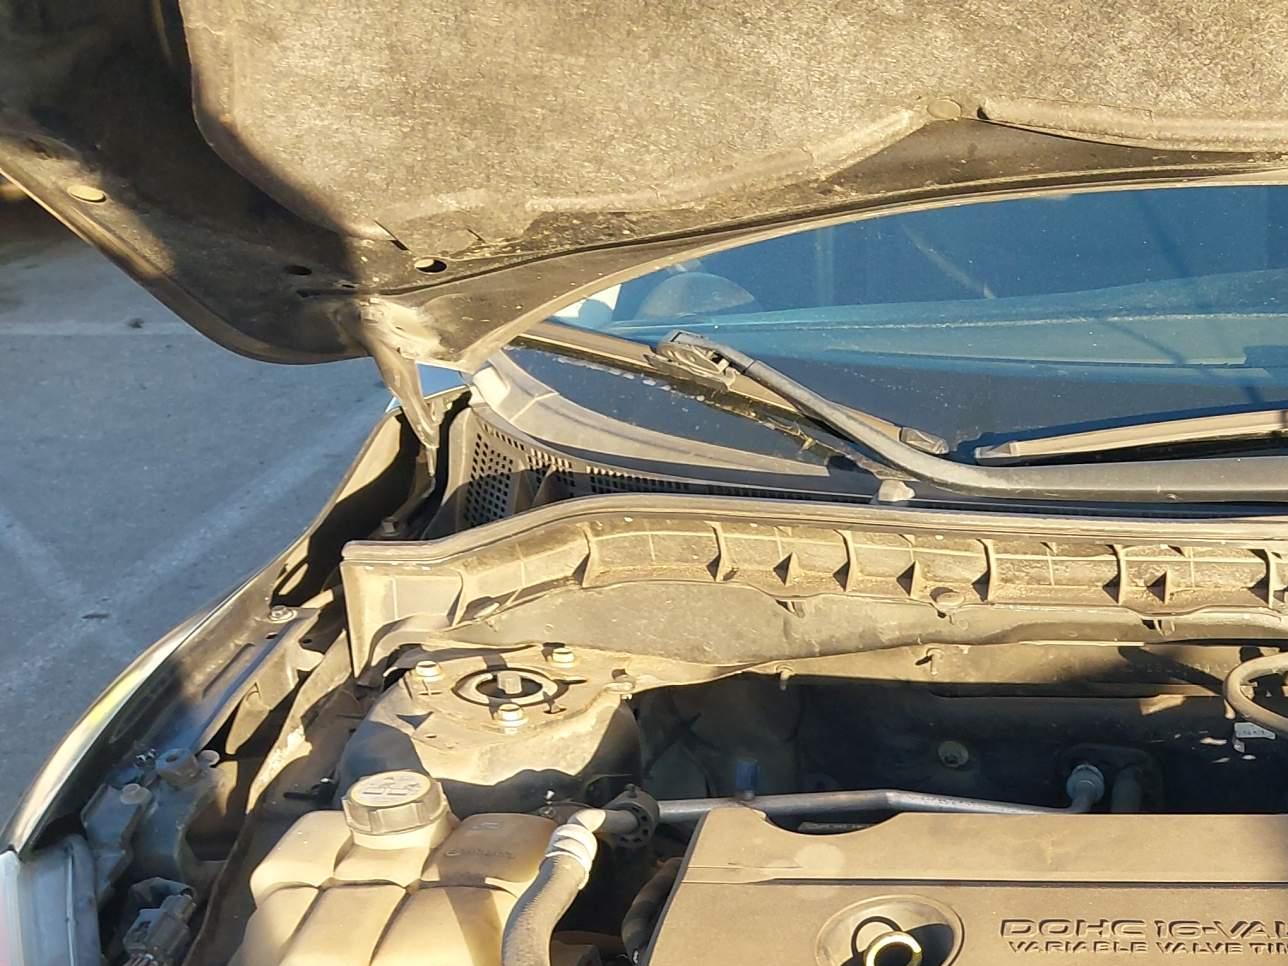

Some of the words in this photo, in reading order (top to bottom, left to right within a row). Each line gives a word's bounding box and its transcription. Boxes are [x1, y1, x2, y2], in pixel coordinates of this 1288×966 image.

[1000, 918, 1146, 939] DOHC
[1008, 940, 1147, 955] VARIABLE
[1155, 941, 1243, 955] VALVE
